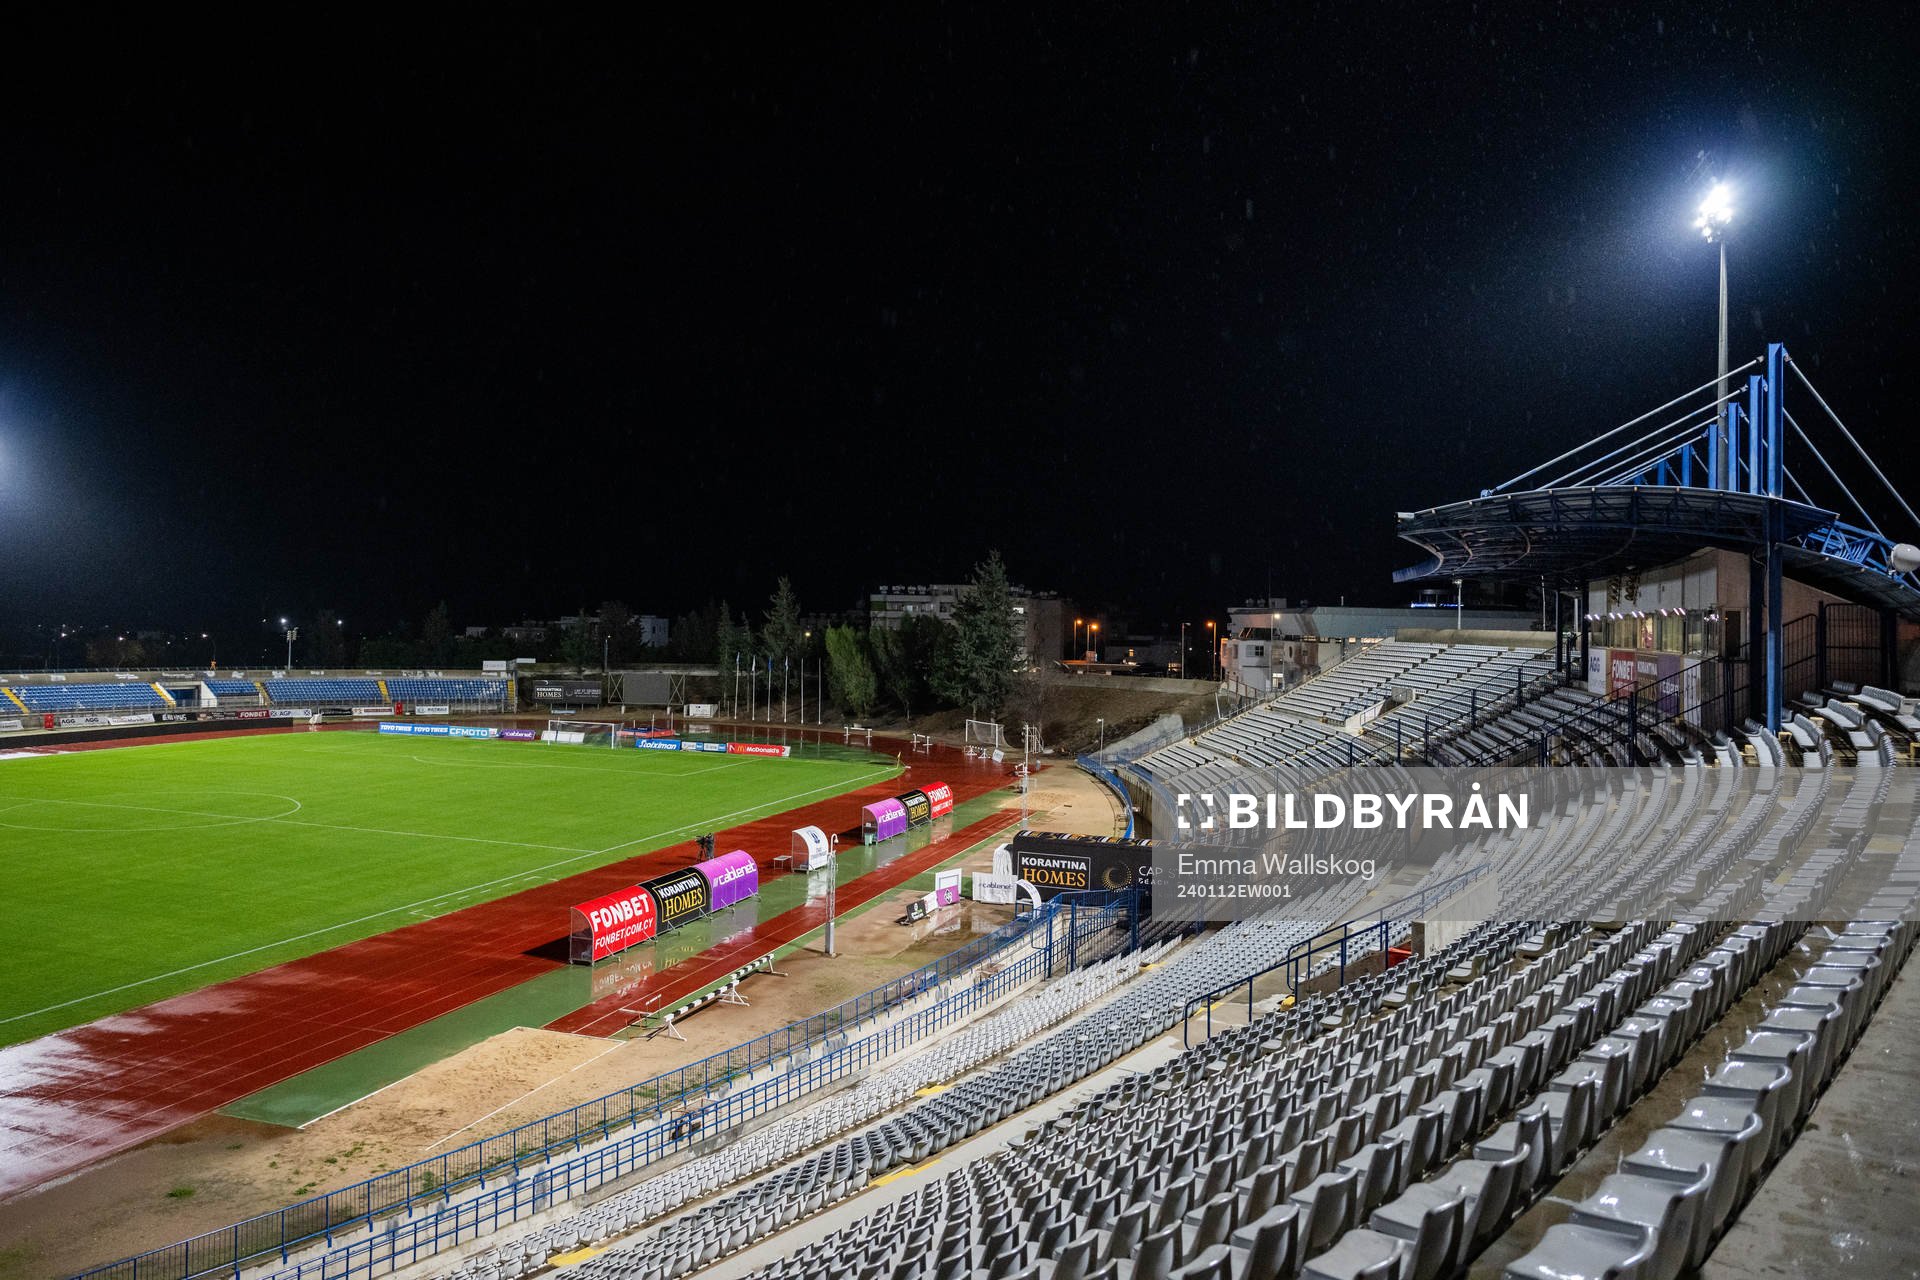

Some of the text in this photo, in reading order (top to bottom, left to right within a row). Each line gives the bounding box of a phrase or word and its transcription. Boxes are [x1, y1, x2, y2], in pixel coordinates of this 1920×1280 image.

[1612, 659, 1634, 681] FONBET
[239, 710, 267, 718] FONBET
[450, 727, 487, 737] CFMOTO
[746, 746, 780, 755] McDonald's
[717, 860, 757, 886] cablenet
[1021, 856, 1087, 871] KORANTINA
[1138, 865, 1163, 877] CAP
[657, 877, 701, 899] KORANTINA
[981, 881, 1013, 890] cablenet
[1022, 868, 1087, 888] HOMES
[590, 893, 650, 932] FONBET
[665, 888, 703, 919] HOMES
[595, 917, 654, 951] FONBET.COM.CY
